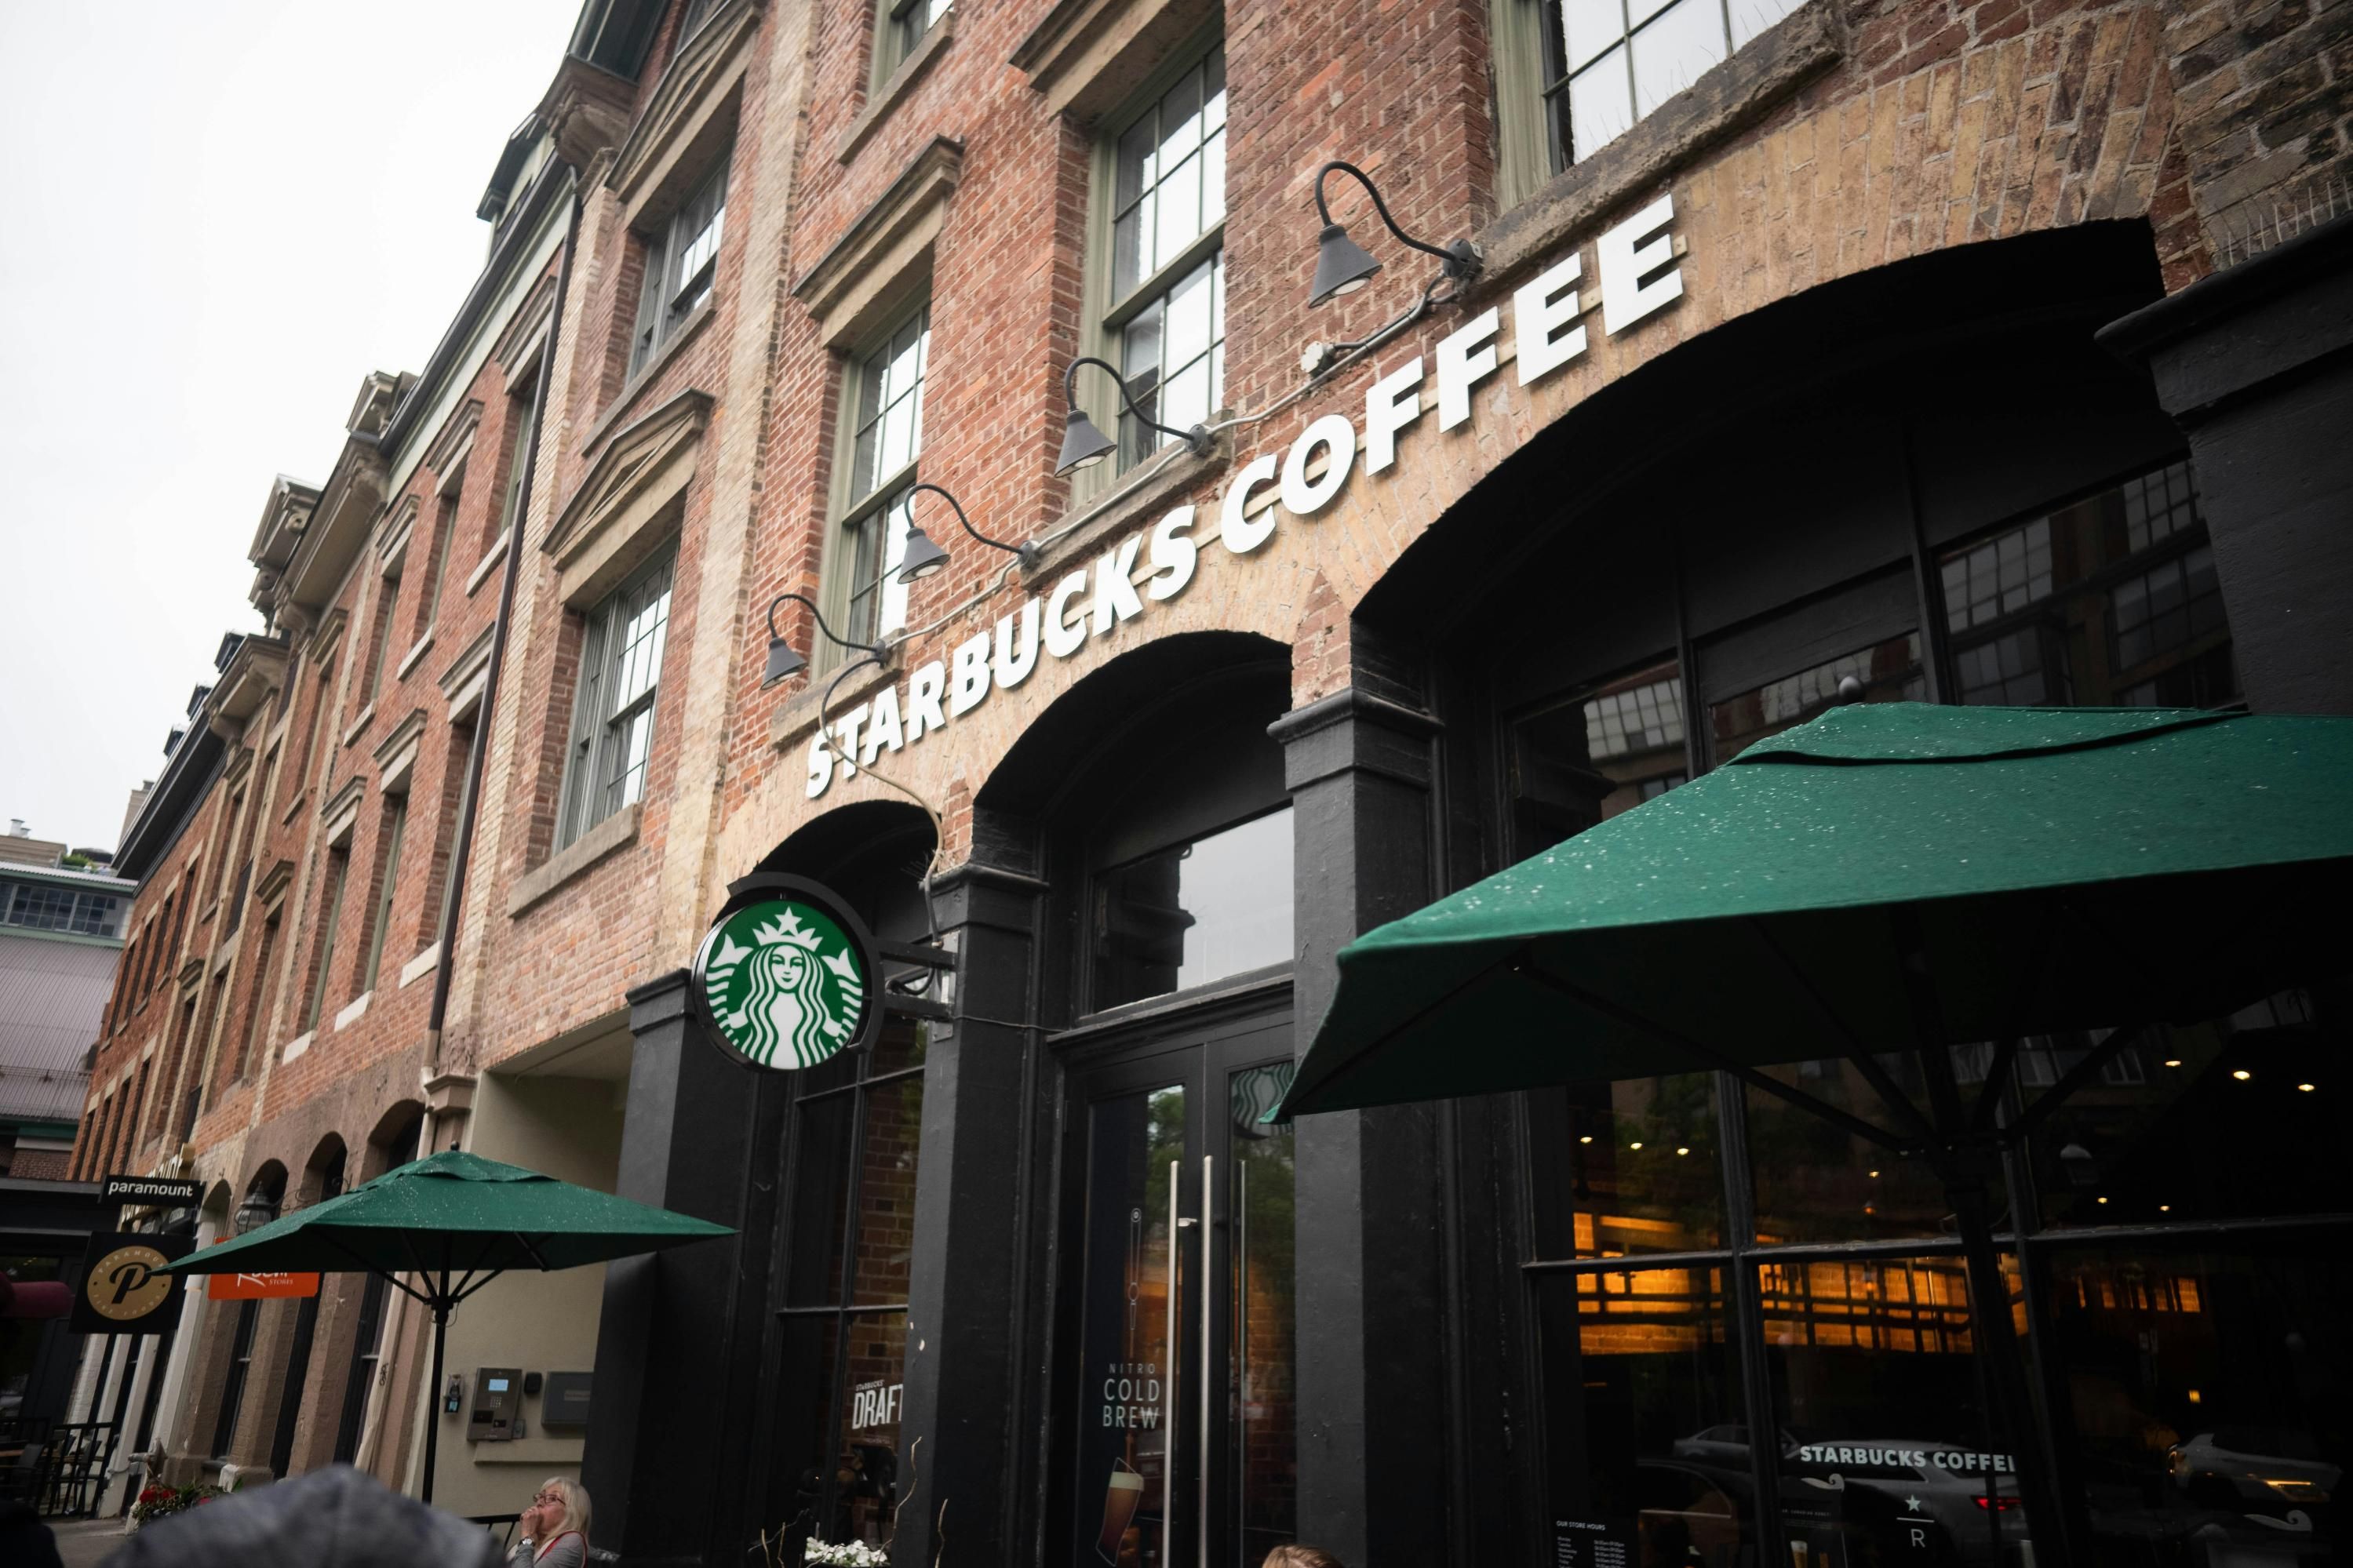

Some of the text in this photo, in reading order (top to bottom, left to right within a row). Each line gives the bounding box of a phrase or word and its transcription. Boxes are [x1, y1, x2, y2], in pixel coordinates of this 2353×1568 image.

[806, 194, 1683, 799] STARBUCKS COFFEE
[107, 1181, 193, 1196] paramount
[109, 1261, 152, 1304] P
[1109, 1362, 1155, 1373] NITRO
[1104, 1378, 1160, 1401] COLD
[1102, 1405, 1159, 1429] BREW
[1801, 1446, 1926, 1467] STARBUCKS
[1910, 1529, 1925, 1548] R
